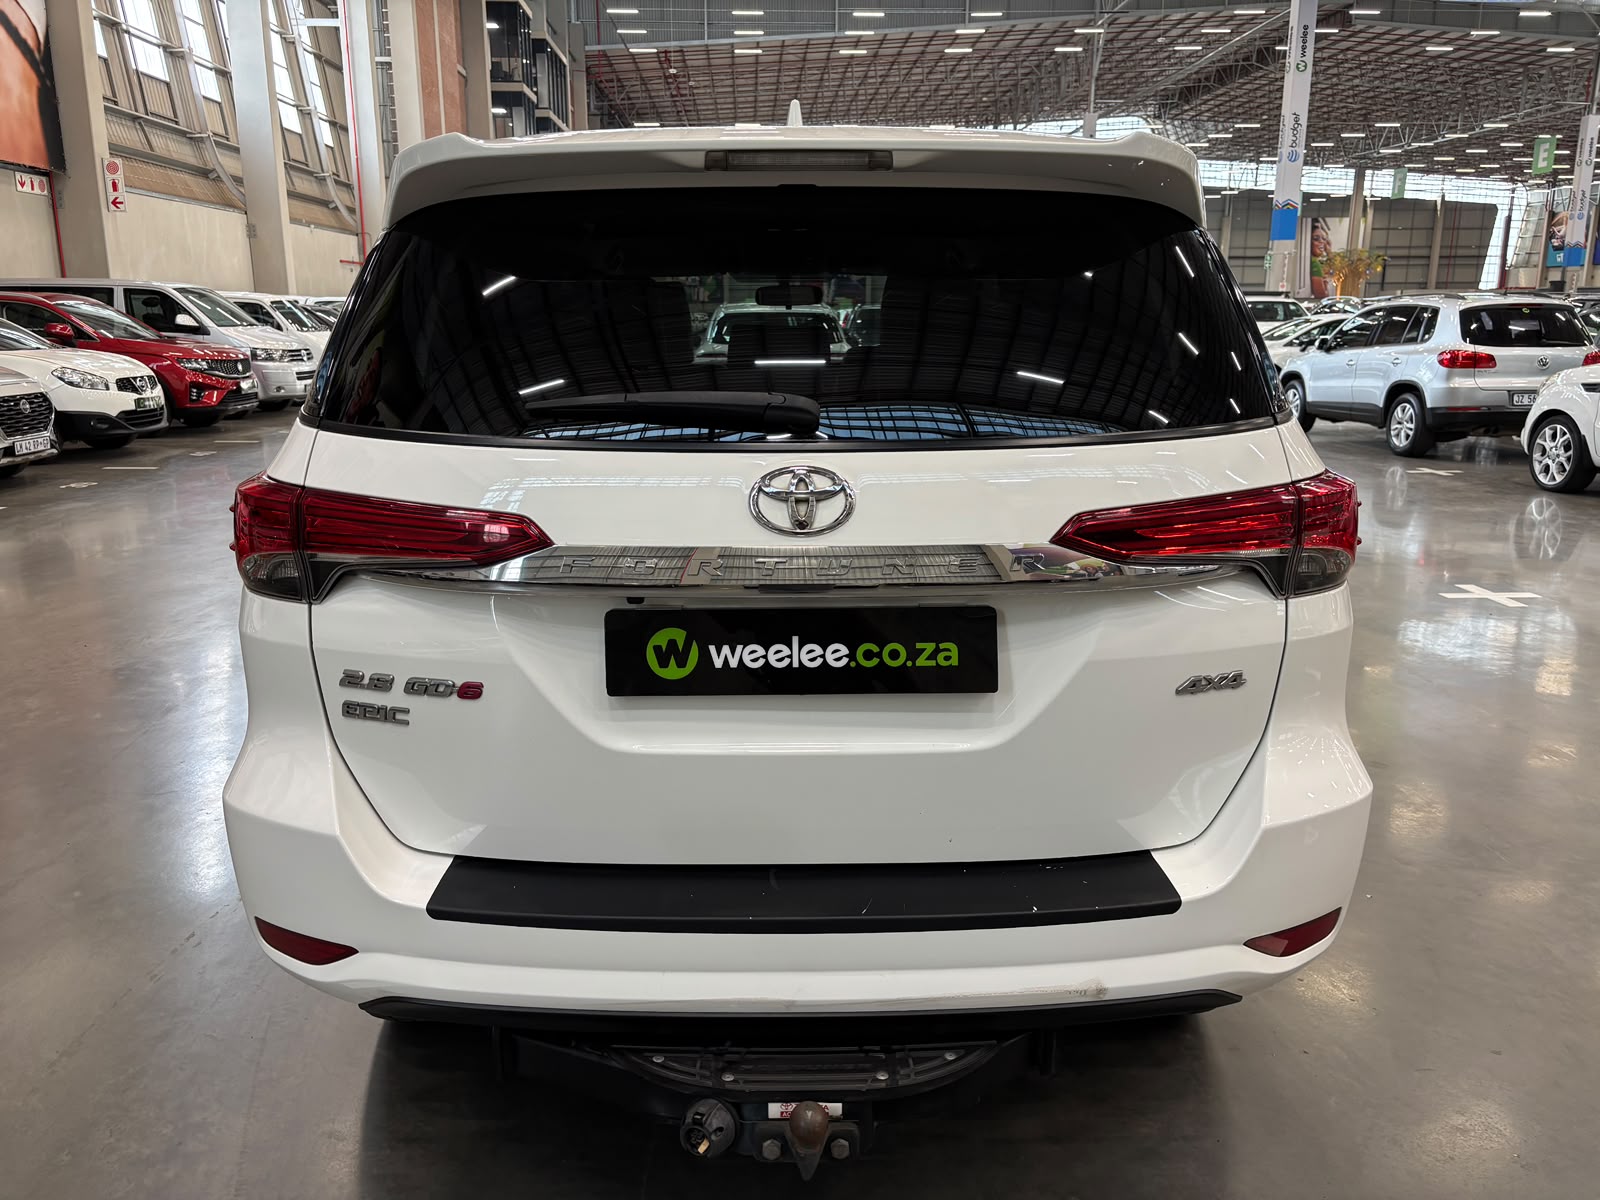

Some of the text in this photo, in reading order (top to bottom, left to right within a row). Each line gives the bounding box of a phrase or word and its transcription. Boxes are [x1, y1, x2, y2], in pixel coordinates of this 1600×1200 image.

[1300, 24, 1309, 58] weelee
[1289, 112, 1302, 148] budget
[1538, 142, 1550, 168] E
[559, 552, 1046, 577] FORTUNER
[708, 635, 959, 668] weelee.co.za
[339, 669, 484, 700] 2.8 GD-6
[341, 699, 410, 726] EPIC
